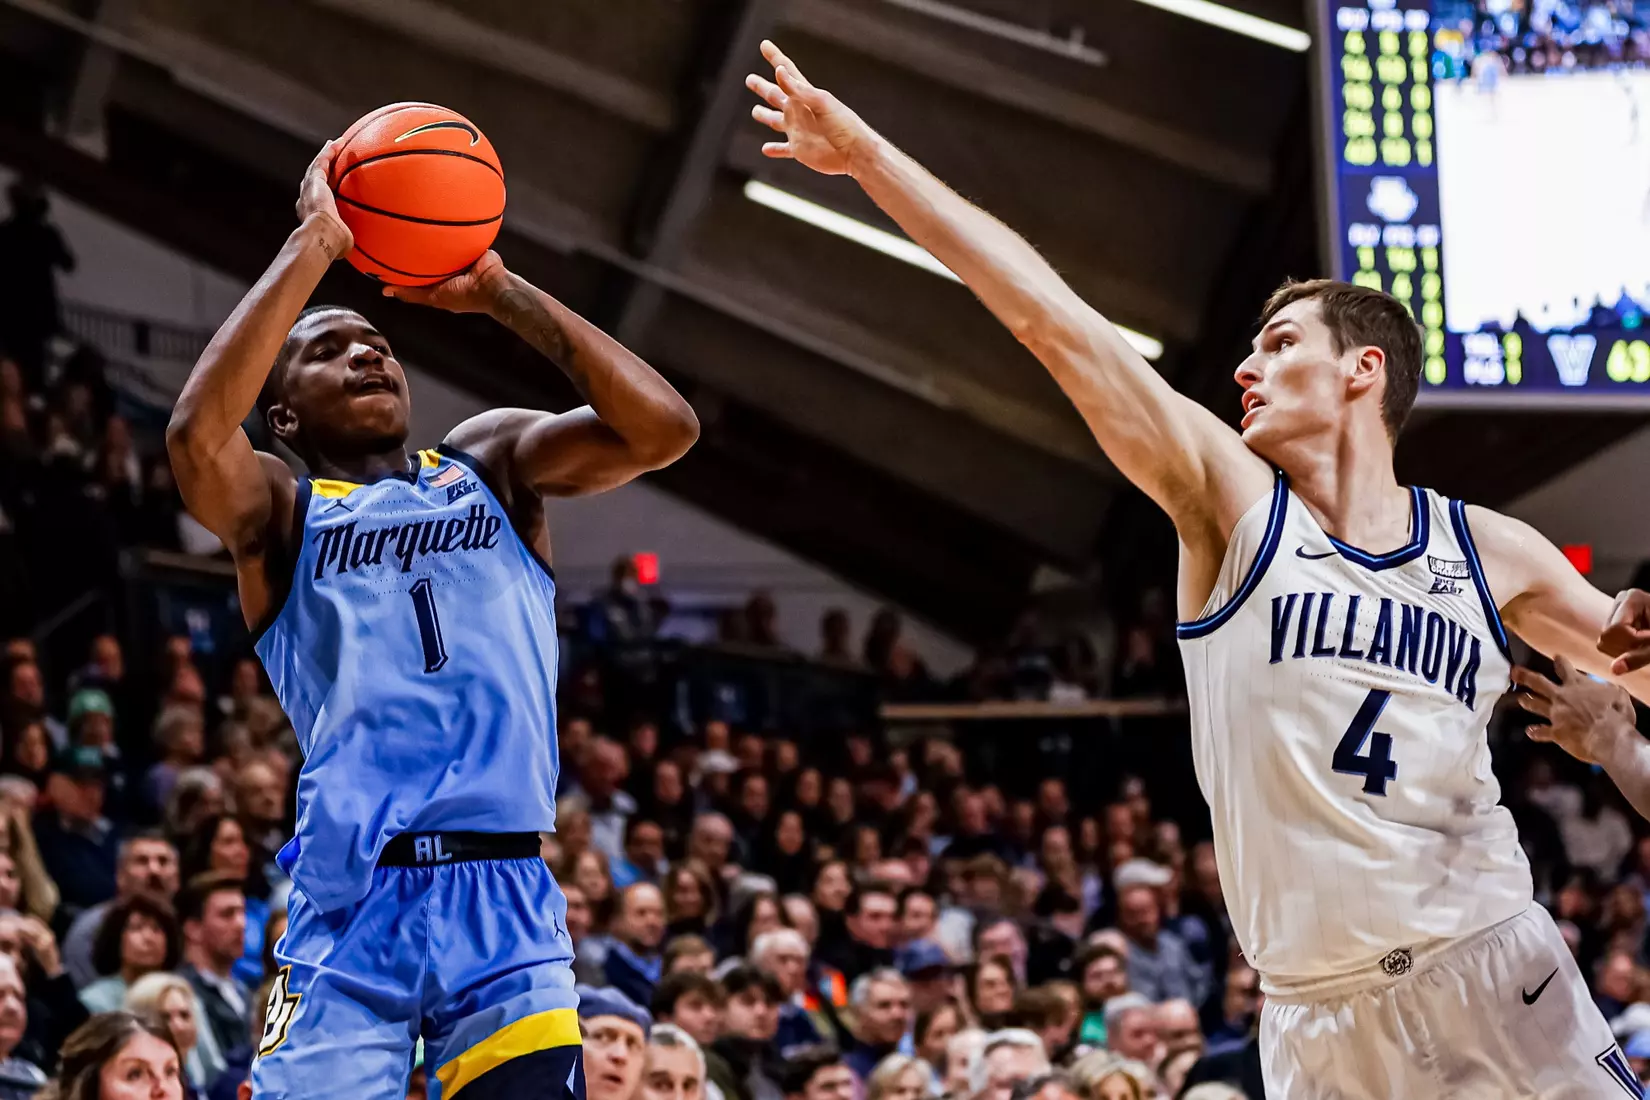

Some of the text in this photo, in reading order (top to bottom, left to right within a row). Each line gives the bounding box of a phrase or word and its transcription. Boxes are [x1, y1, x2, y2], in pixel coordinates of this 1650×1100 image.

[312, 504, 501, 580] Marquette
[1430, 583, 1465, 595] EAST
[408, 578, 448, 674] 1
[1268, 592, 1482, 712] VILLANOVA
[1331, 688, 1398, 797] 4
